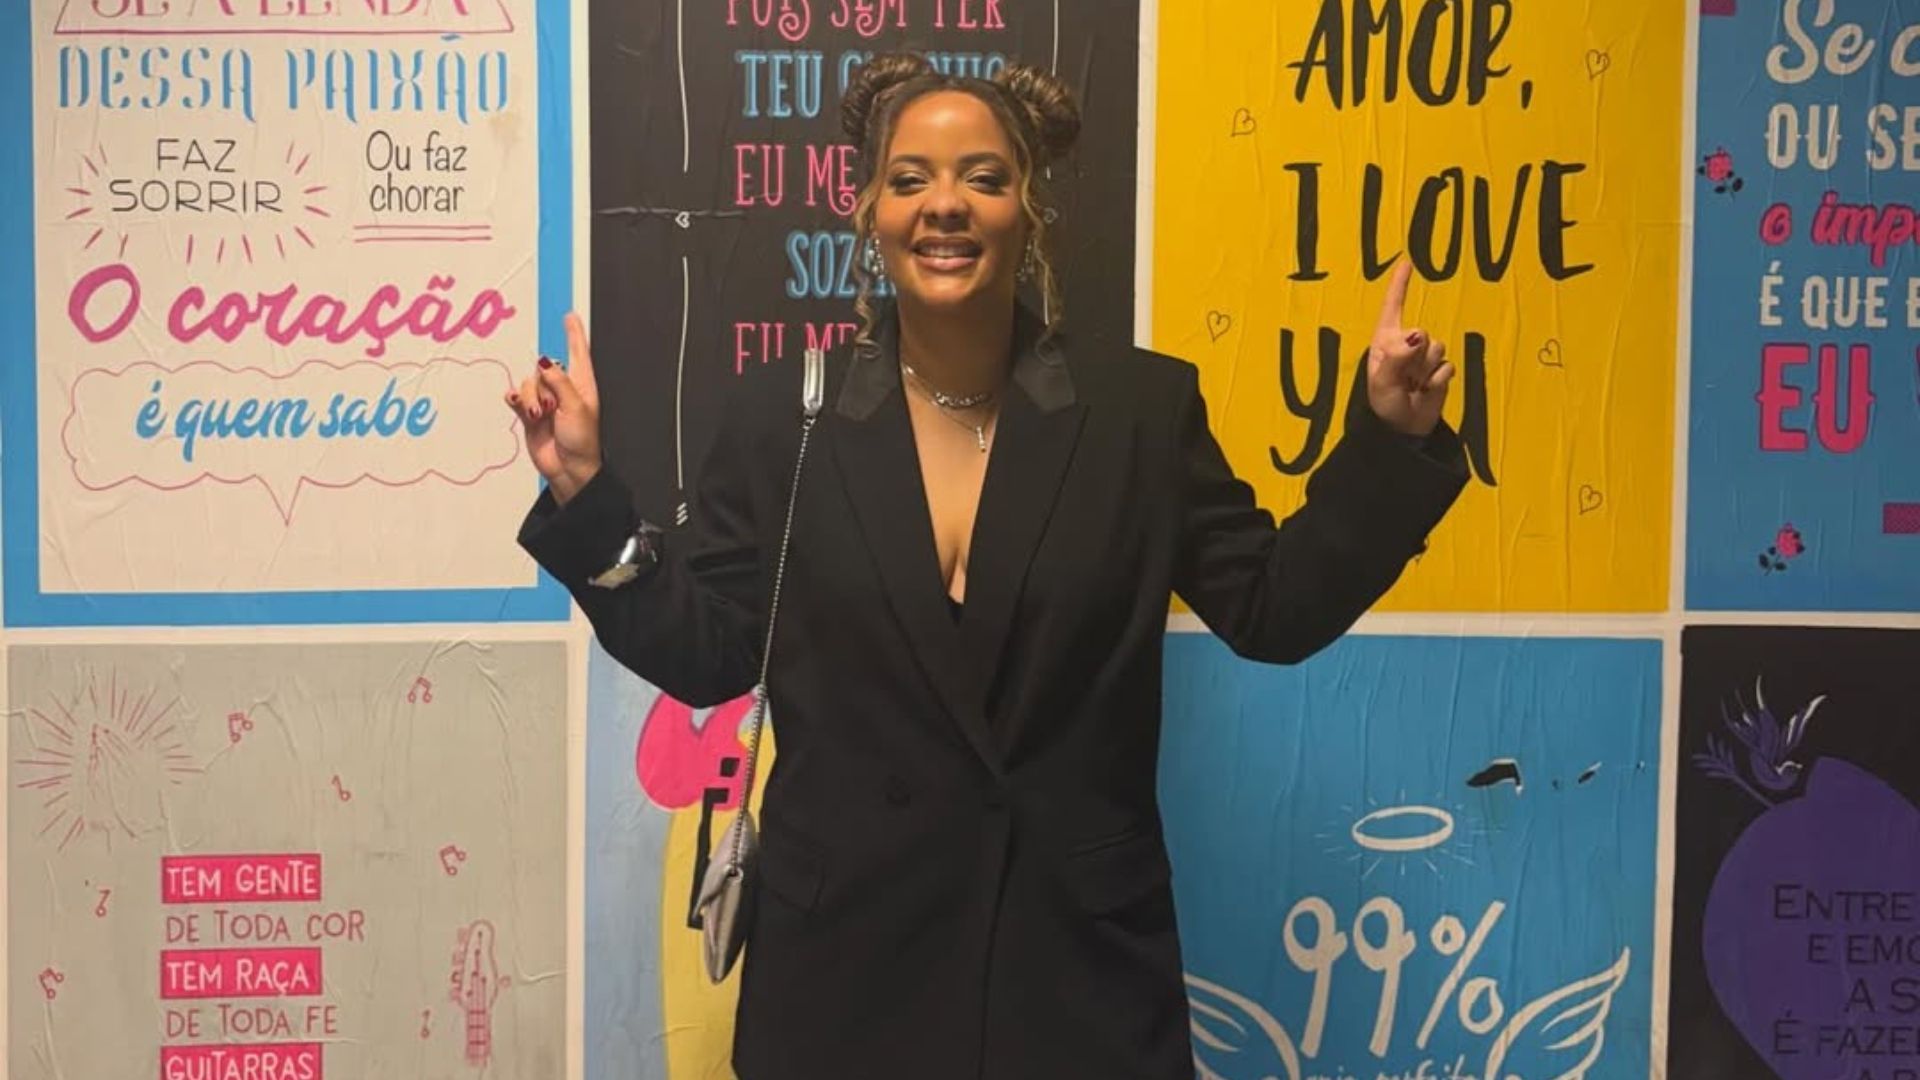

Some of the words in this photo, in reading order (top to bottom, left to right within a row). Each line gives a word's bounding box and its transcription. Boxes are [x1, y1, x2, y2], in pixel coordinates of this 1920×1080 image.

[1286, 0, 1534, 110] AMOR,
[59, 45, 256, 123] DESSA
[286, 34, 509, 125] PAIXÃO
[734, 51, 824, 118] TEU
[156, 138, 237, 172] FAZ
[366, 130, 412, 172] Ou
[423, 131, 468, 172] faz
[1764, 102, 1843, 170] OU
[110, 179, 283, 213] SORRIR
[369, 173, 465, 212] chorar
[734, 143, 786, 207] EU
[1283, 162, 1329, 281] I
[1361, 160, 1596, 283] LOVE
[1759, 202, 1793, 246] o
[68, 263, 142, 343] O
[167, 275, 517, 357] coração
[1759, 260, 1785, 327] É
[1801, 274, 1890, 331] QUE
[135, 380, 168, 438] é
[175, 394, 314, 462] quem
[319, 378, 438, 438] sabe
[1756, 342, 1877, 454] EU
[166, 866, 221, 897] TEM
[235, 859, 318, 896] GENTE
[1773, 884, 1915, 922] ENTRE
[166, 915, 200, 943] DE
[214, 910, 291, 942] TODA
[306, 909, 365, 942] COR
[1807, 933, 1834, 964] E
[166, 958, 222, 991] TEM
[235, 959, 309, 995] RAÇA
[1283, 896, 1506, 1059] 99%
[1844, 977, 1876, 1013] A
[166, 1009, 200, 1038] DE
[216, 1004, 291, 1036] TODA
[306, 1005, 337, 1034] FE
[1773, 1010, 1802, 1054] É
[165, 1050, 314, 1080] GUITARRAS
